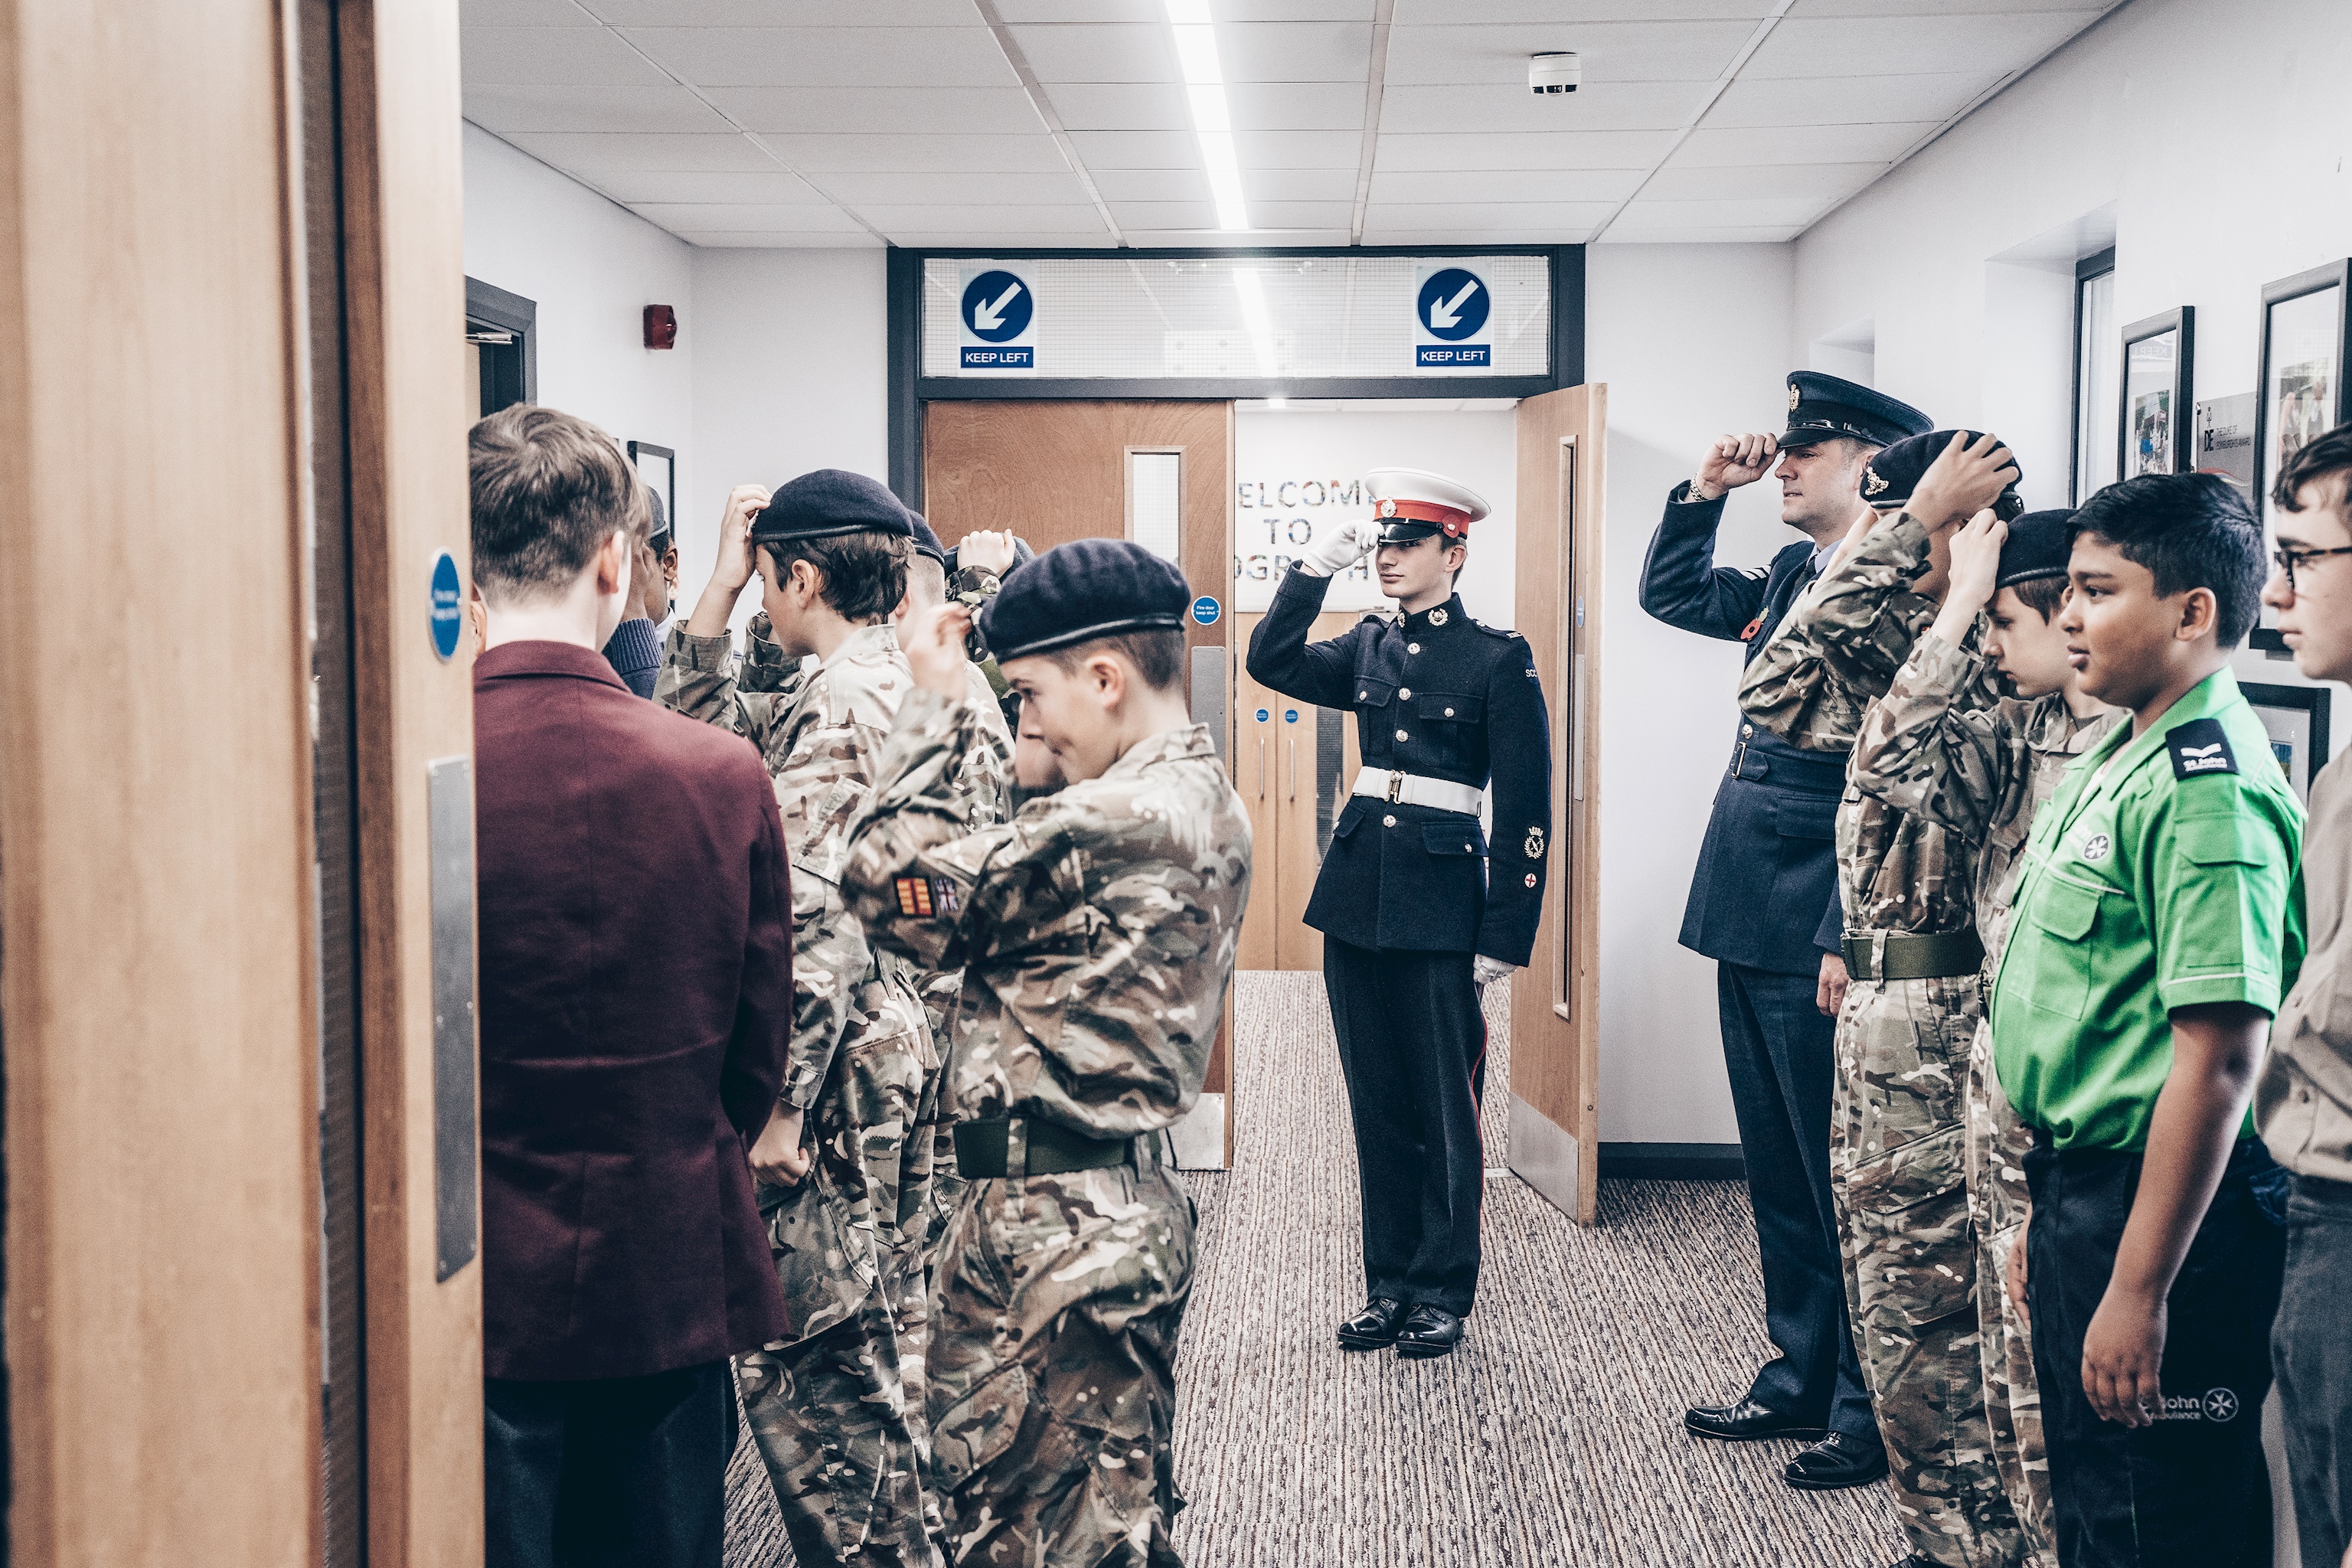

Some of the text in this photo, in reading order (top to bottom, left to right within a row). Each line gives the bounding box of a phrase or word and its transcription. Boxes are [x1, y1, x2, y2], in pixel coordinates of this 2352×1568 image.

[965, 353, 1029, 363] KEEP LEFT
[1421, 351, 1485, 361] KEEP LEFT
[1238, 480, 1376, 508] ELCOM
[1263, 518, 1312, 545] TO
